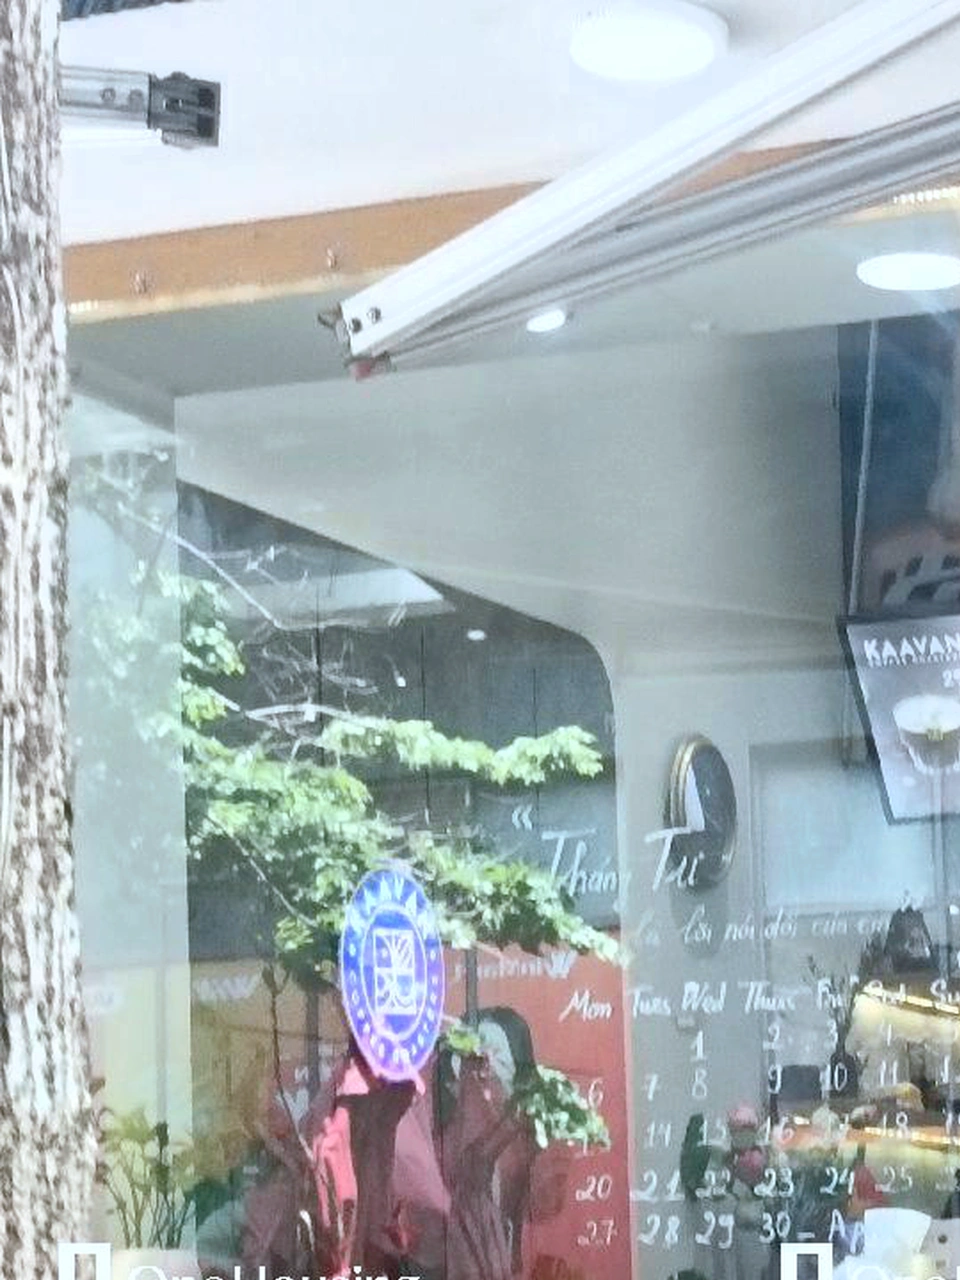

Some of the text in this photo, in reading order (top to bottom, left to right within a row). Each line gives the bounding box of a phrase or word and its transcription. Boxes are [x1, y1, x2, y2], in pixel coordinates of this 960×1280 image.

[558, 988, 613, 1022] Mon
[689, 1031, 708, 1061] 1
[762, 1023, 785, 1051] 2
[691, 1068, 708, 1099] 8
[767, 1063, 783, 1094] 9
[820, 1063, 848, 1092] 10
[880, 1059, 900, 1087] 11
[882, 1111, 911, 1139] 18
[575, 1173, 613, 1201] 20
[633, 1169, 686, 1200] 21
[694, 1167, 732, 1198] 22
[753, 1166, 795, 1198] 23
[819, 1166, 855, 1196] 24
[874, 1166, 913, 1193] 25
[577, 1218, 618, 1246] 27
[637, 1213, 681, 1247] 28
[695, 1210, 736, 1249] 29
[758, 1210, 792, 1244] 30
